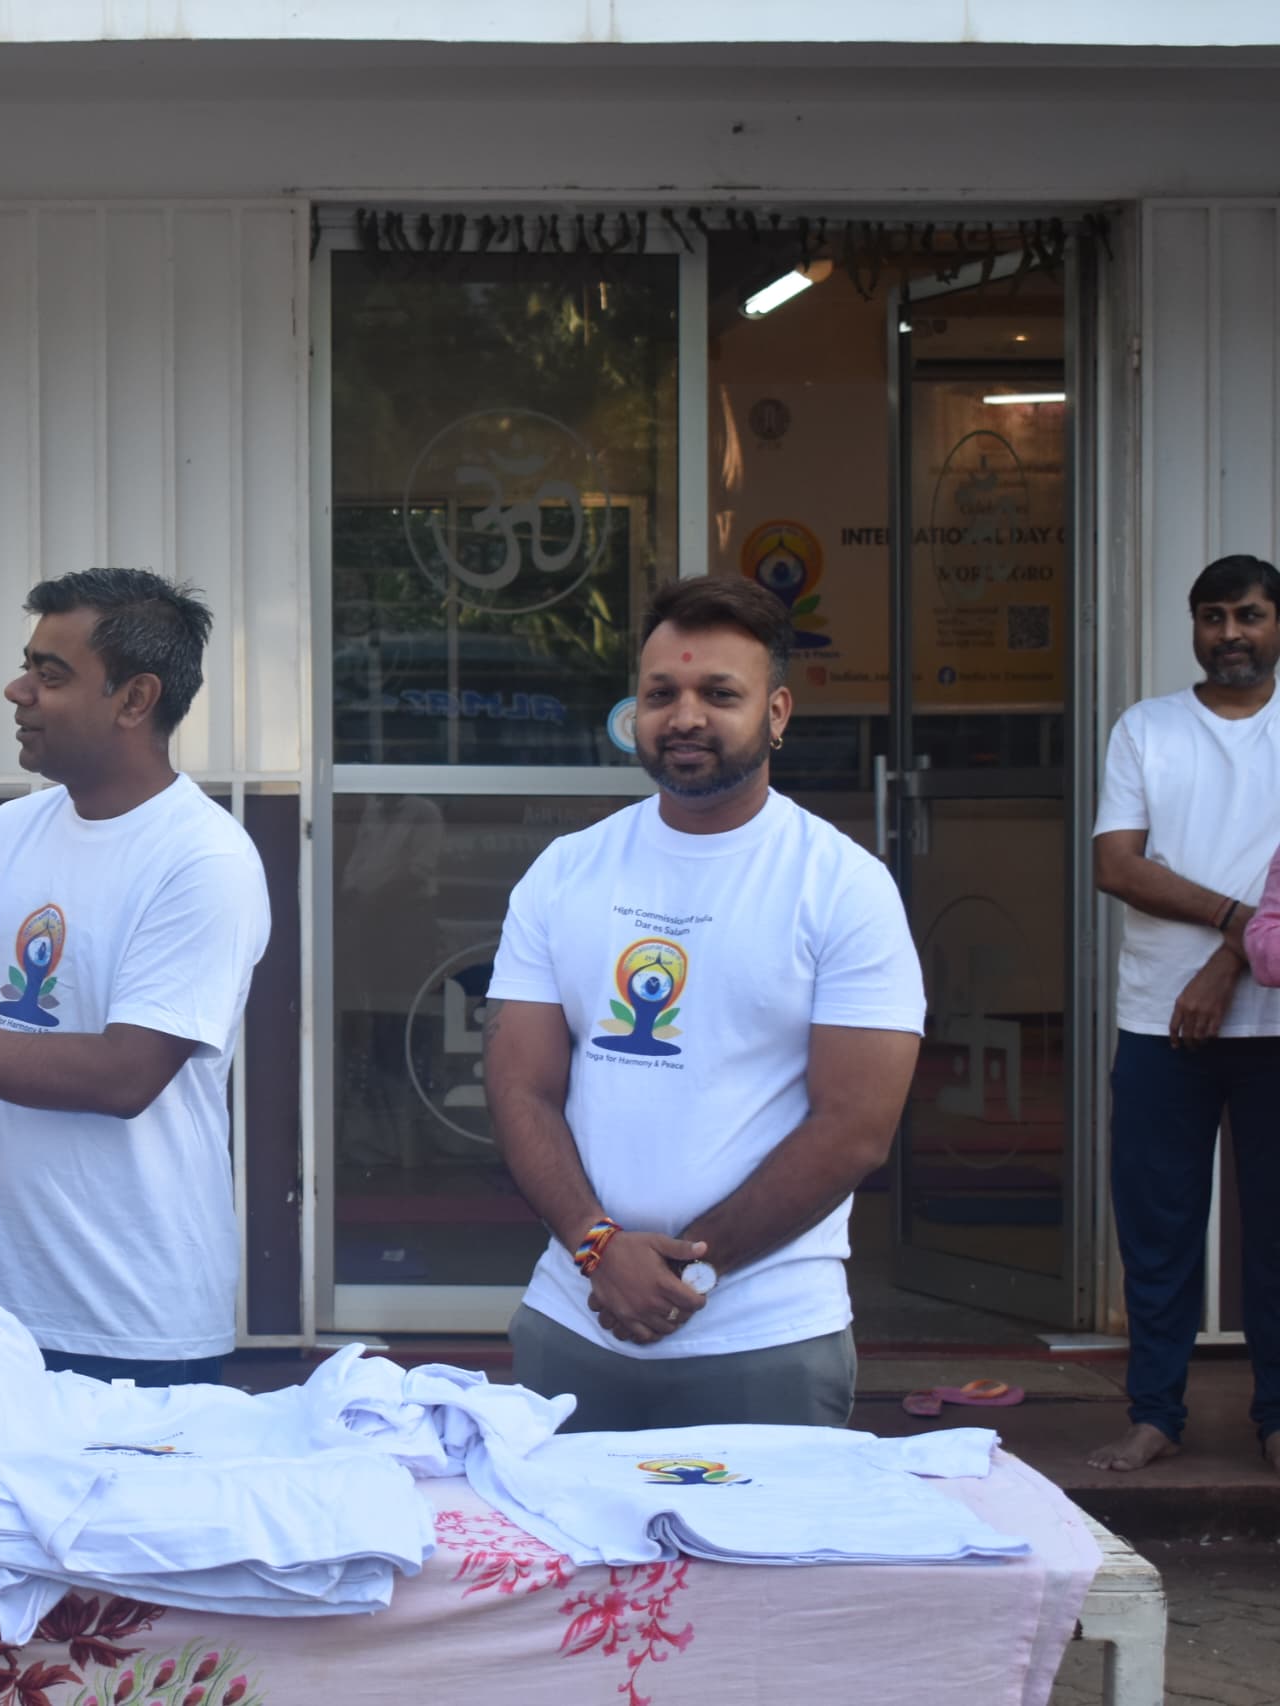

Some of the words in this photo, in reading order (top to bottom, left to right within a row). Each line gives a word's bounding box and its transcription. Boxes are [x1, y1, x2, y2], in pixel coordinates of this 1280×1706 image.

[1008, 527, 1049, 546] DAY
[613, 904, 634, 917] High
[634, 919, 652, 930] Dar
[652, 925, 663, 934] es
[585, 1050, 605, 1062] Yoga
[606, 1053, 617, 1063] for
[618, 1055, 653, 1069] Harmony
[661, 1059, 685, 1071] Peace
